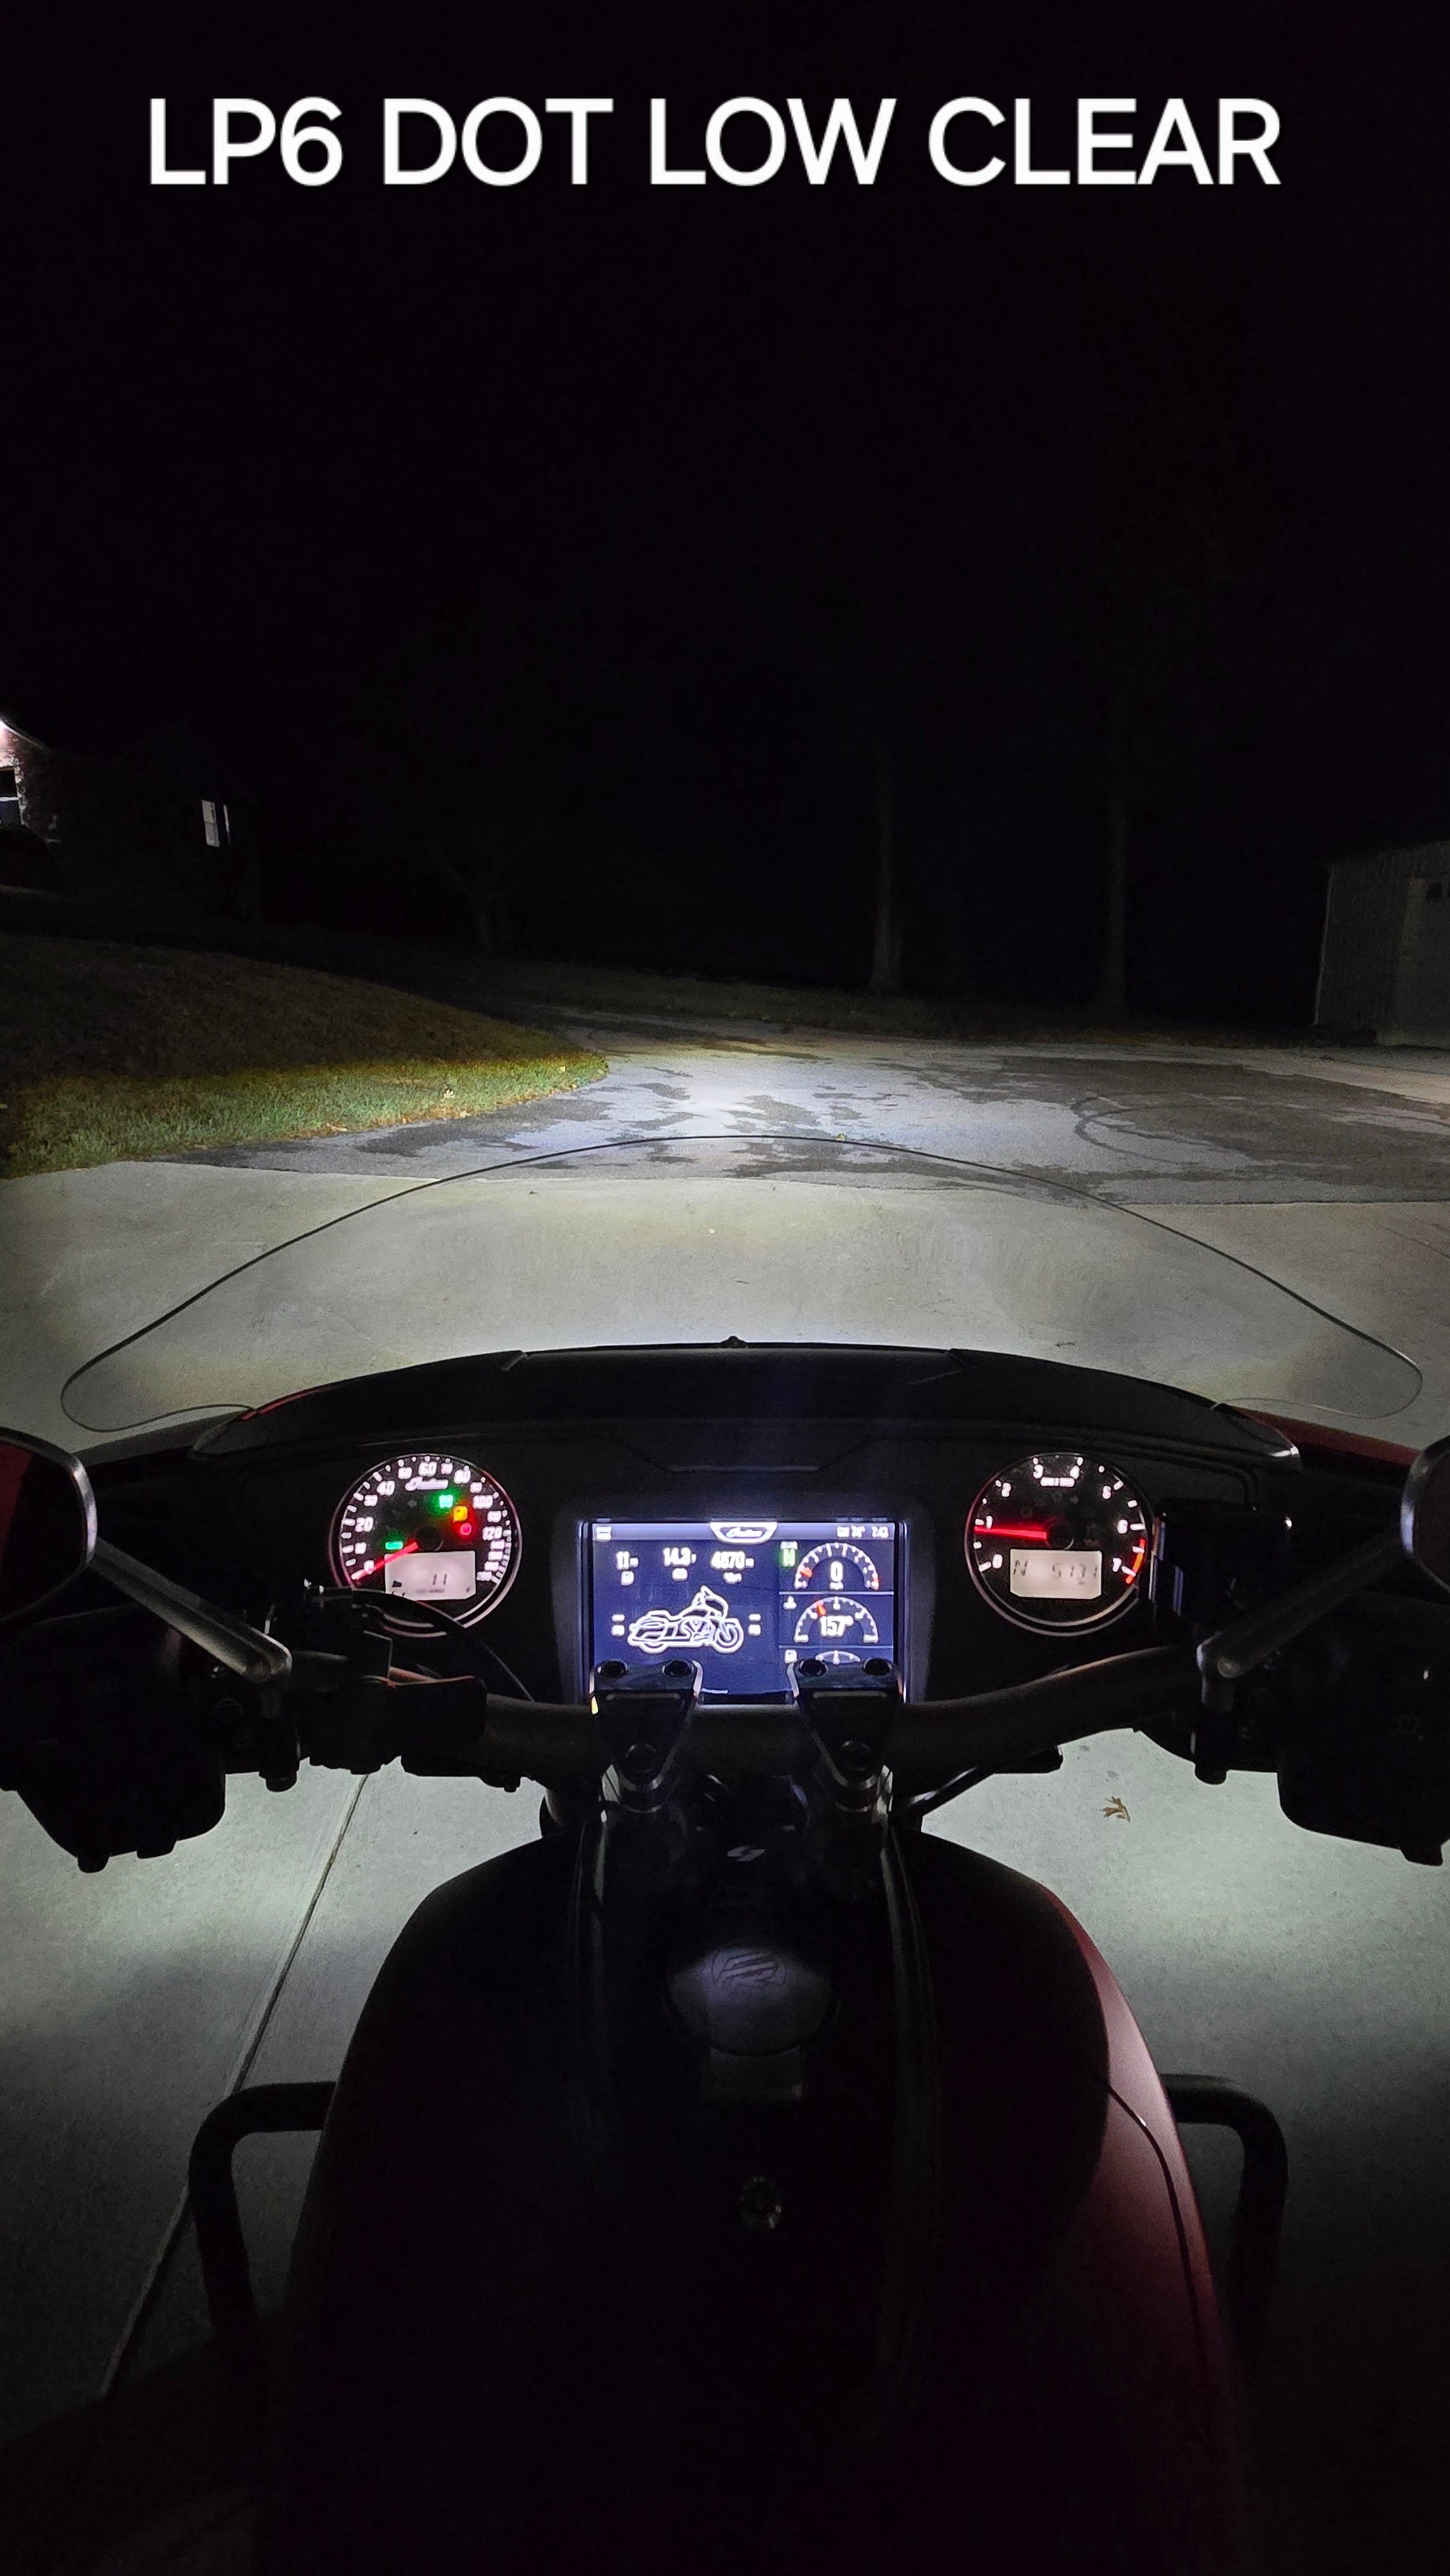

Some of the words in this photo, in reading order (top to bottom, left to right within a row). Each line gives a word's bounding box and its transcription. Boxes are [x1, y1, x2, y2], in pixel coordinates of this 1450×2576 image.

[419, 1461, 437, 1477] 60
[1033, 1465, 1043, 1479] 3
[376, 1481, 395, 1495] 40
[1001, 1483, 1011, 1497] 2
[355, 1517, 373, 1532] 20
[483, 1526, 503, 1540] 120
[992, 1554, 1002, 1568] 0
[830, 1561, 843, 1582] 0
